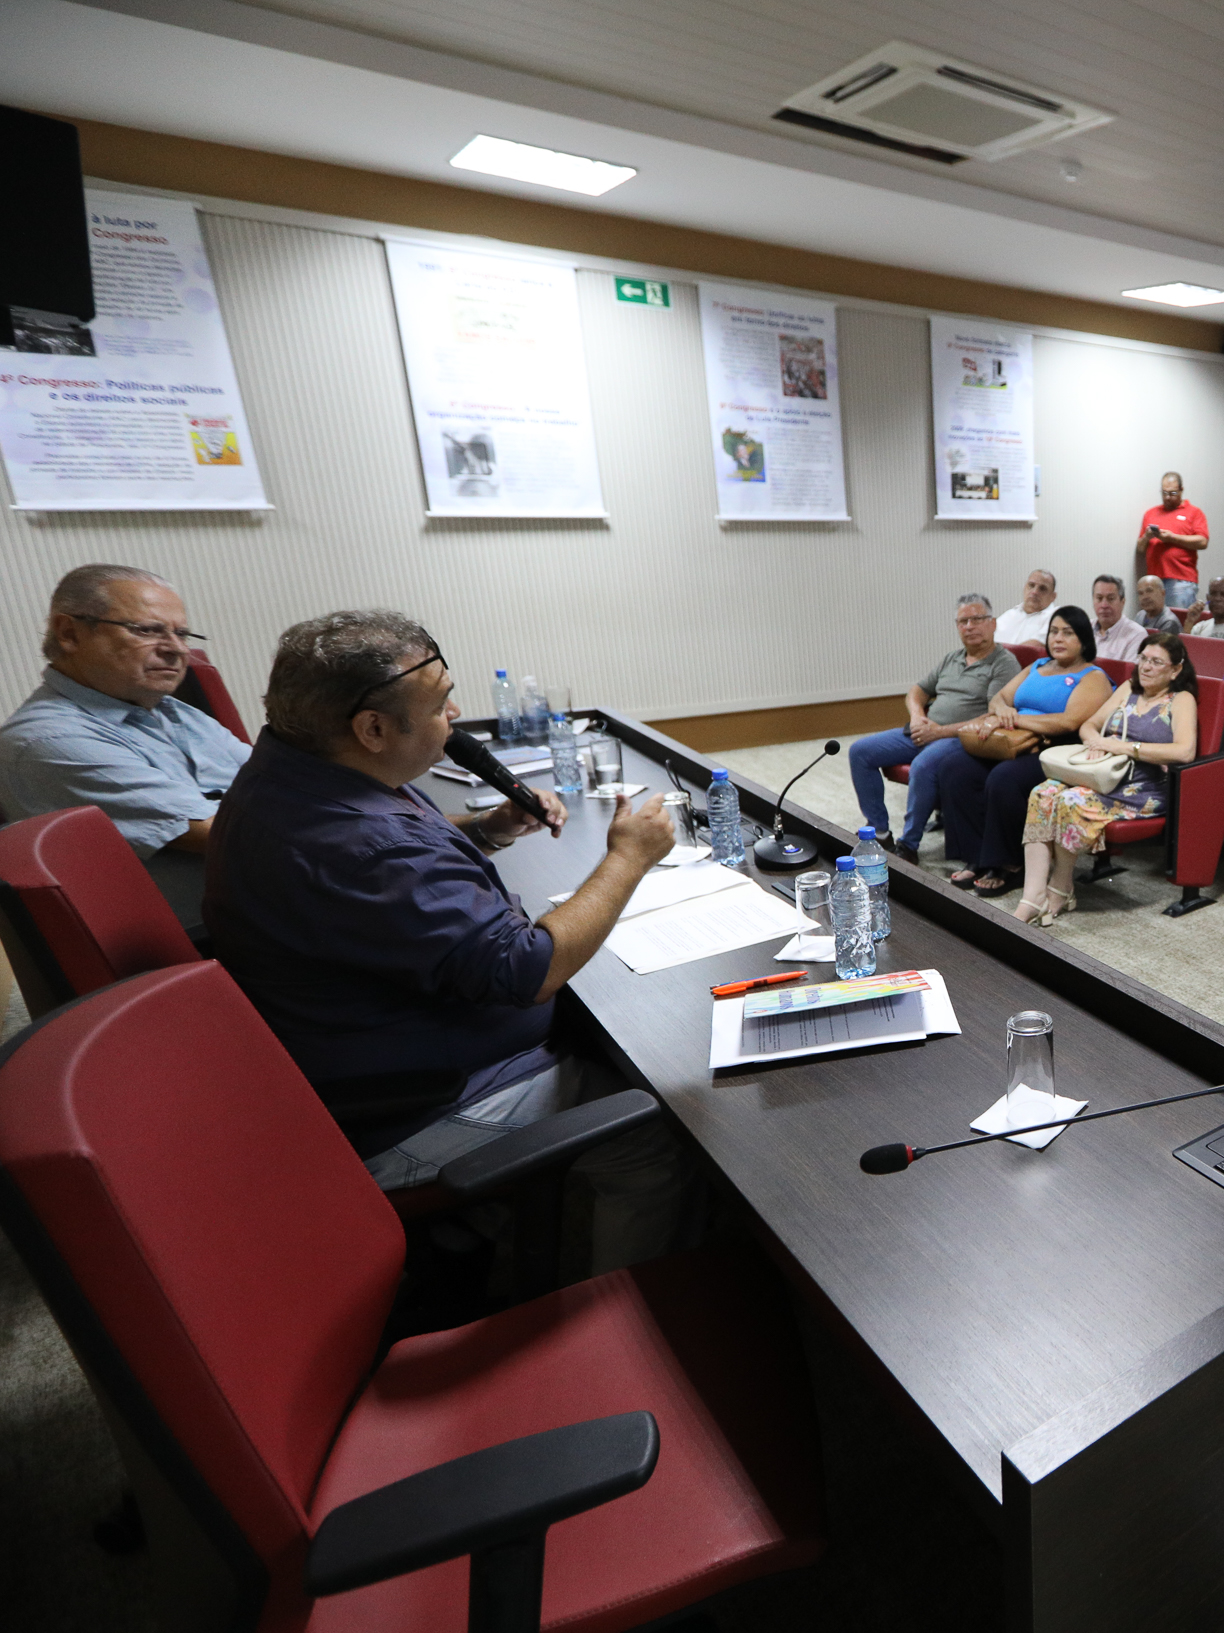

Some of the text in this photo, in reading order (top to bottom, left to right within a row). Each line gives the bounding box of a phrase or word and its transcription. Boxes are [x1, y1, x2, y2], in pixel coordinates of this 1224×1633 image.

[102, 214, 131, 228] luta
[133, 219, 158, 231] por
[92, 227, 169, 245] Congresso
[106, 378, 165, 394] Políticas
[168, 382, 225, 396] públicas
[48, 392, 189, 407] e os direitos sociais
